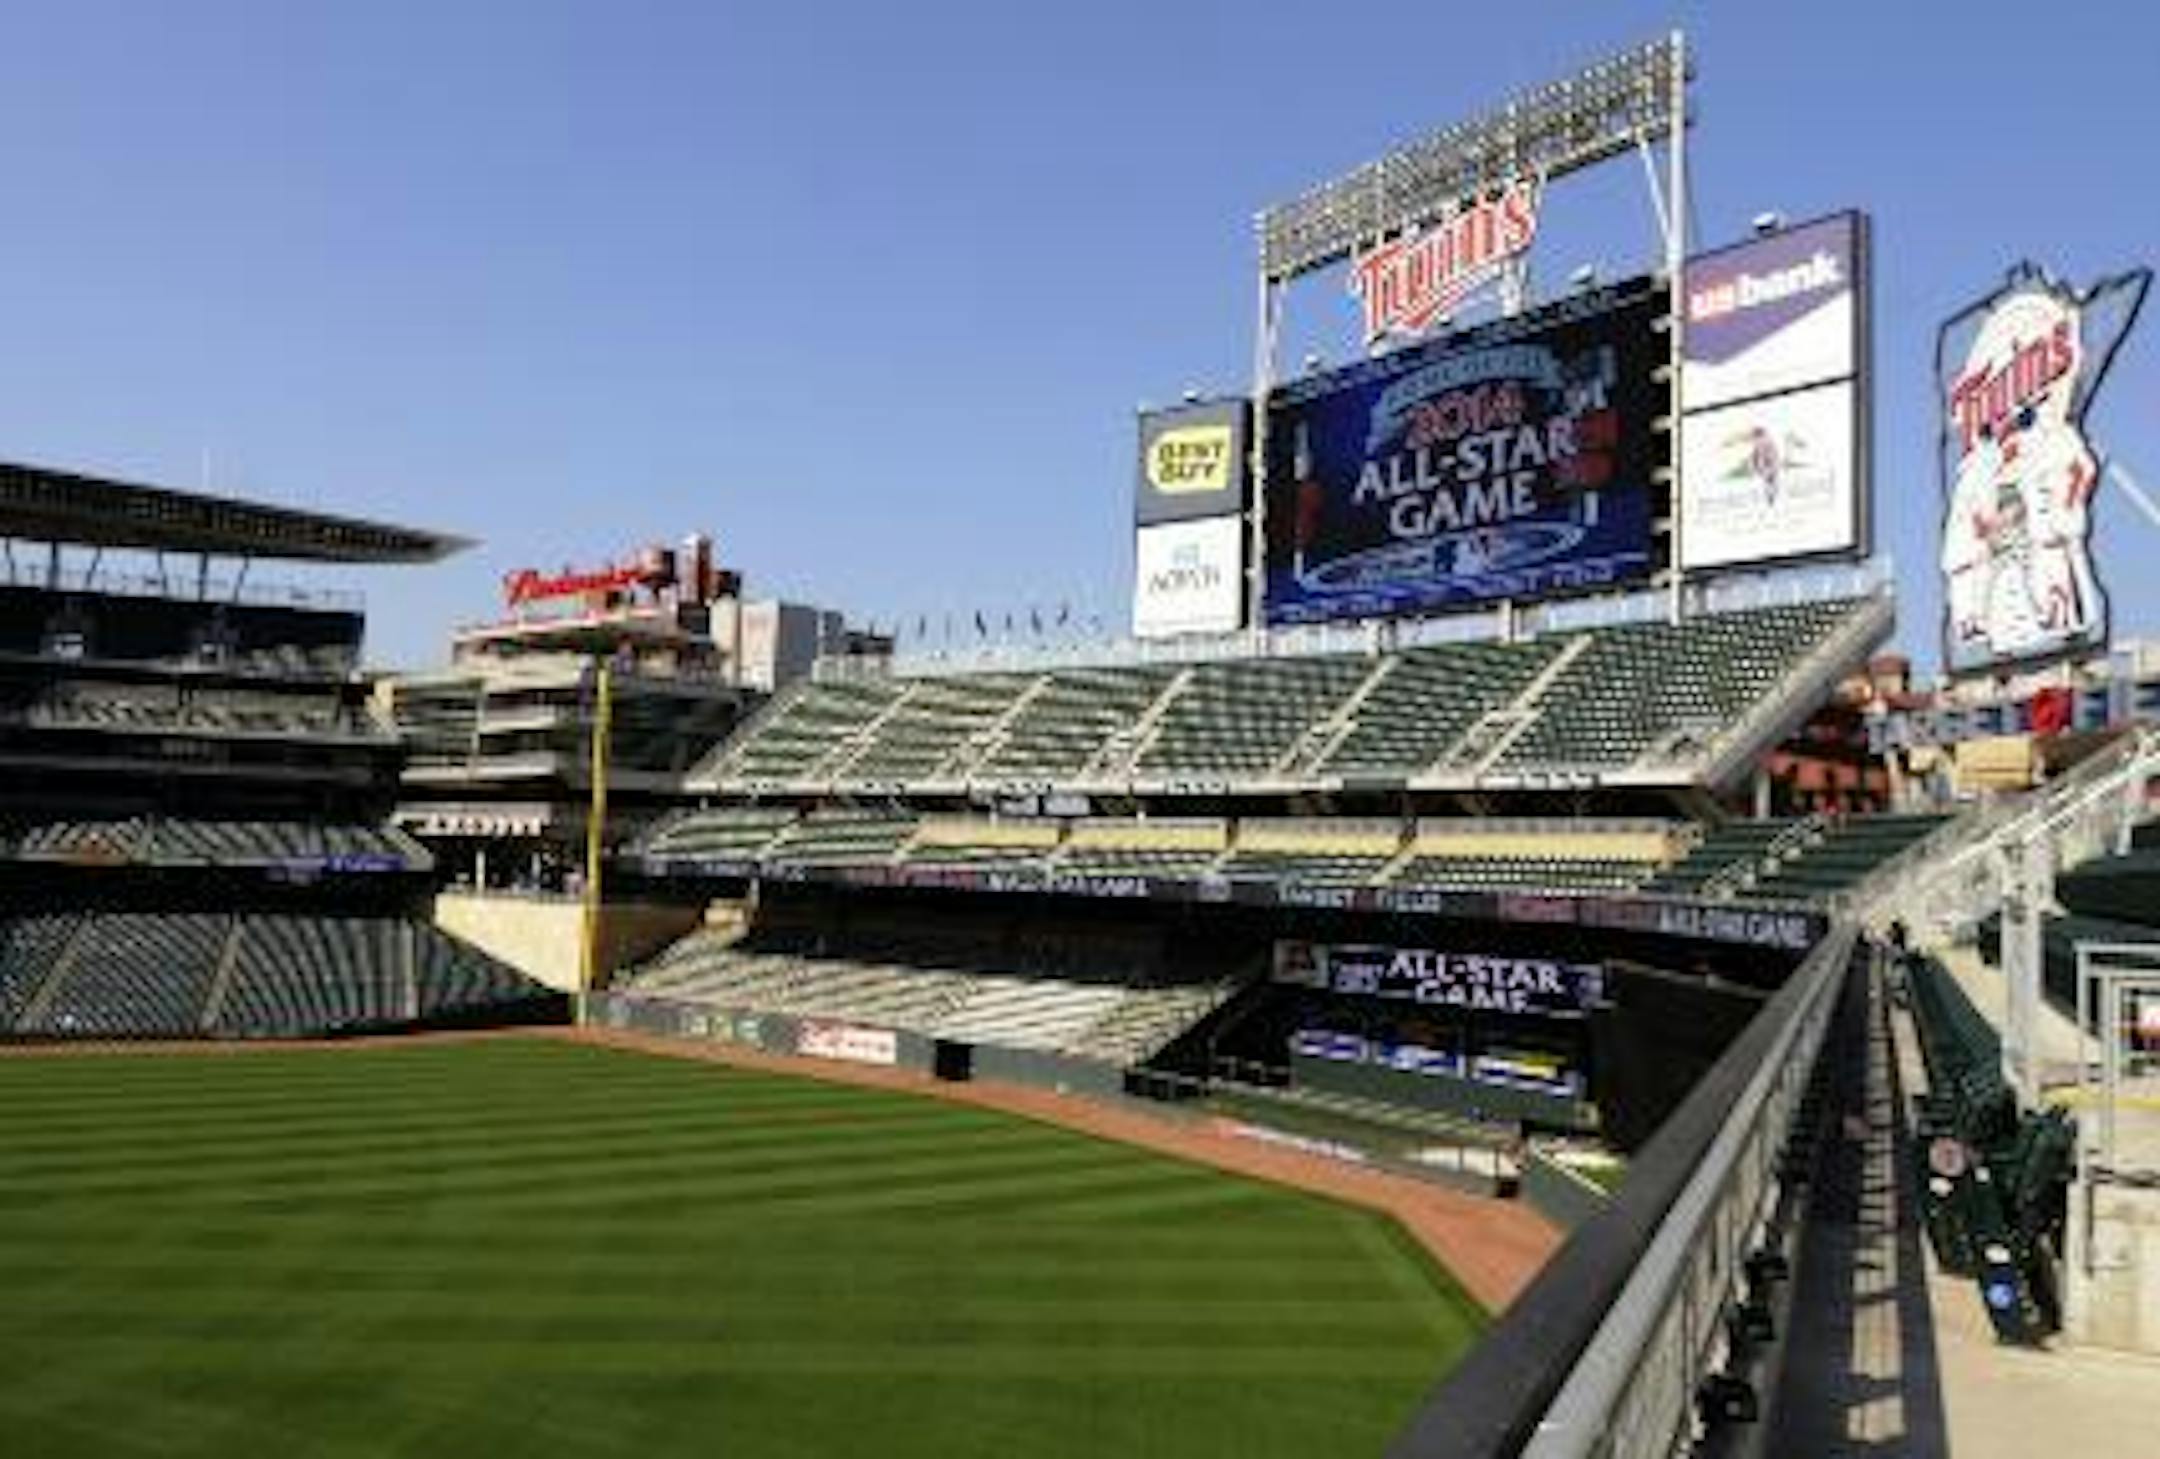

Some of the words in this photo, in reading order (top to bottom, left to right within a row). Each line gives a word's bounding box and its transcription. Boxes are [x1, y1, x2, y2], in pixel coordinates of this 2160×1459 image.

[1355, 180, 1536, 341] Twins
[1951, 320, 2073, 456] Twins
[1354, 414, 1580, 501] ALL-STAR
[1390, 470, 1538, 537] GAME
[1386, 947, 1565, 995] ALL-STAR
[1414, 979, 1530, 1013] GAME
